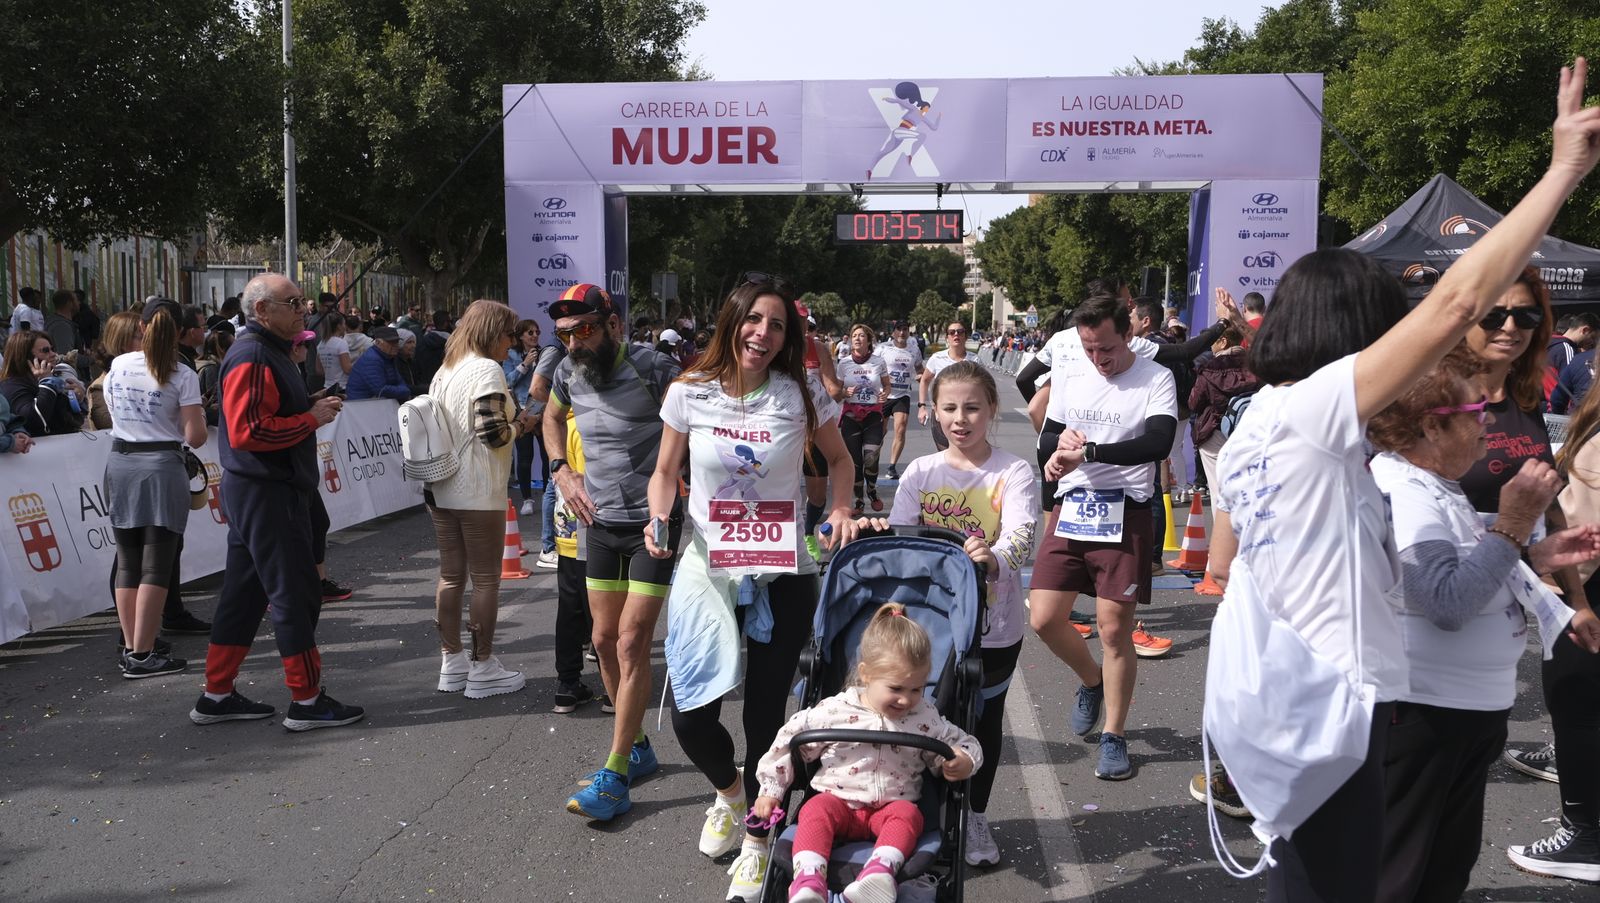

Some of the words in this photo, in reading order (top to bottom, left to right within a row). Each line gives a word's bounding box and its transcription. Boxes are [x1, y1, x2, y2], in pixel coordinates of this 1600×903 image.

[621, 102, 709, 119] CARRERA
[715, 102, 740, 117] DE
[746, 101, 769, 117] LA
[1061, 96, 1083, 111] LA
[1089, 94, 1184, 111] IGUALDAD
[1032, 122, 1055, 137] ES
[1060, 121, 1150, 136] NUESTRA
[1154, 120, 1213, 135] META.
[612, 126, 779, 165] MUJER
[1102, 147, 1137, 155] ALMERÍA
[1040, 147, 1070, 162] CDX
[545, 234, 579, 242] cajamar
[1252, 230, 1290, 239] cajamar
[538, 257, 568, 270] CASI
[1243, 255, 1275, 268] CASI
[1540, 267, 1585, 283] meta
[1068, 407, 1121, 425] CUELLAR
[712, 427, 772, 443] MUJER
[920, 491, 972, 517] OOL
[1076, 503, 1109, 518] 458
[720, 522, 783, 542] 2590
